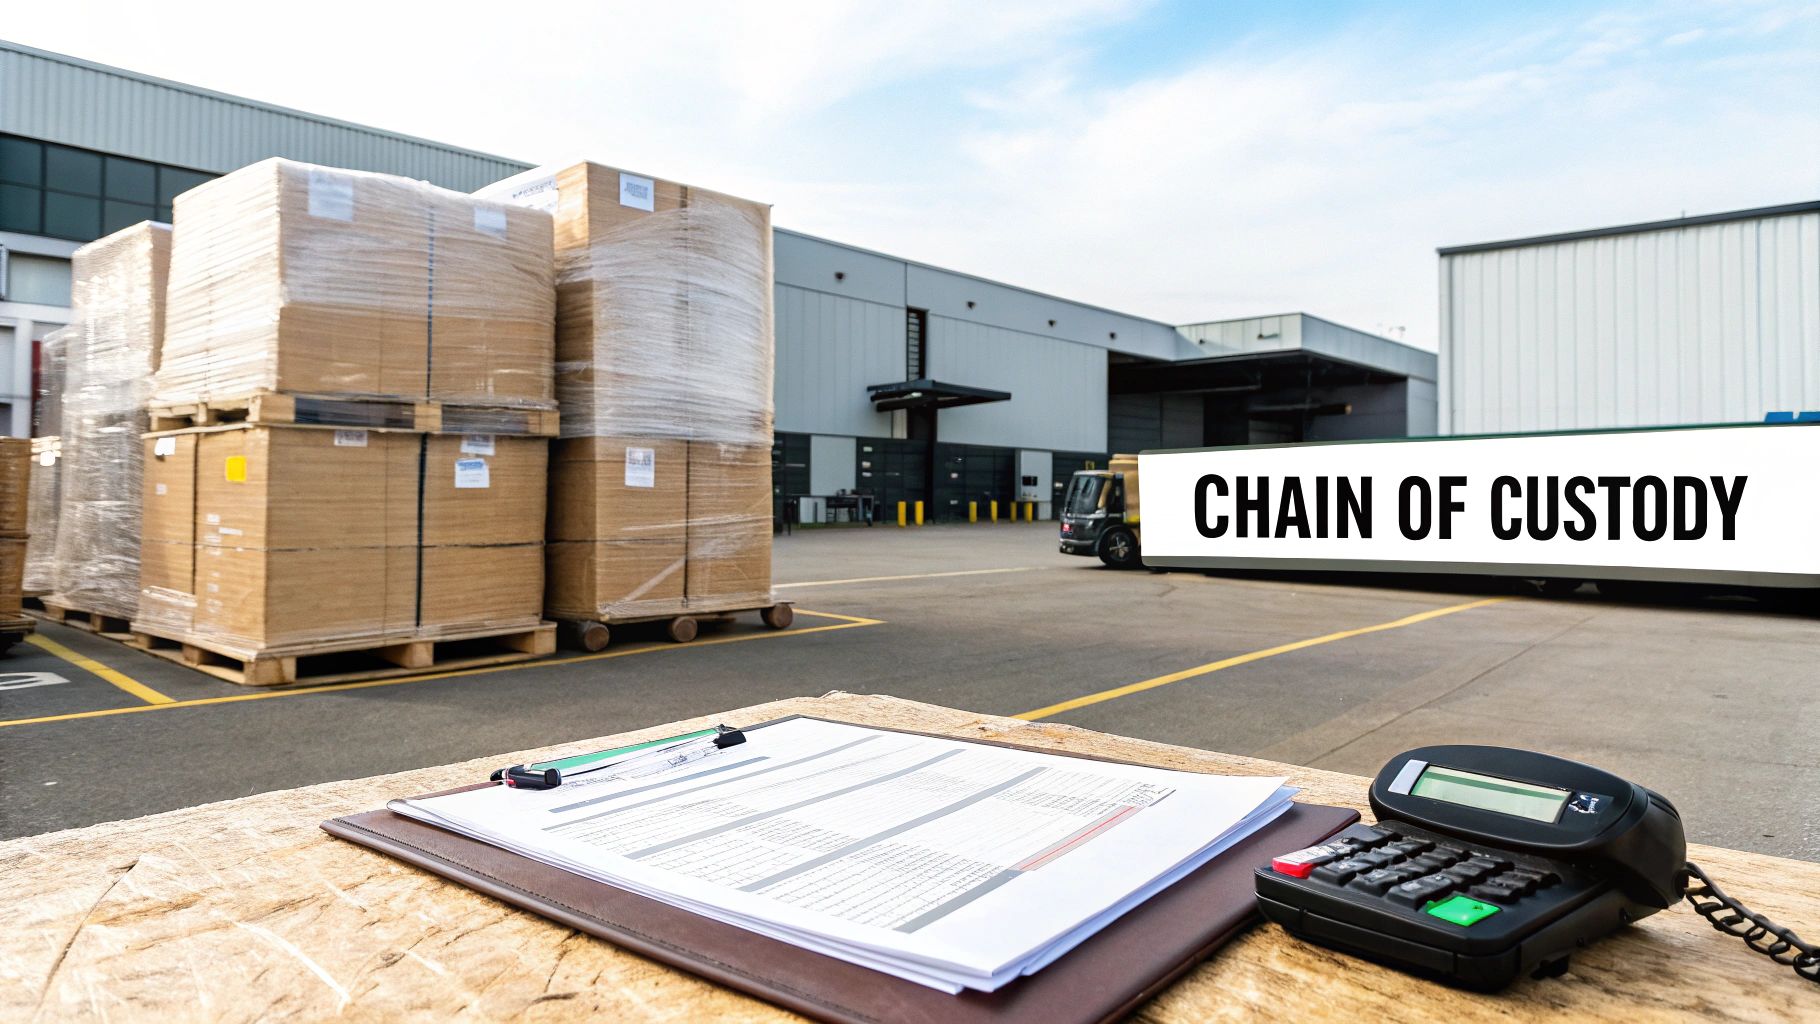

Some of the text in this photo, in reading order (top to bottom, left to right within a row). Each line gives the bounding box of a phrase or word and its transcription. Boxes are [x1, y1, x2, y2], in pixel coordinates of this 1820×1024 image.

[1194, 474, 1749, 542] CHAIN OF CUSTODY
